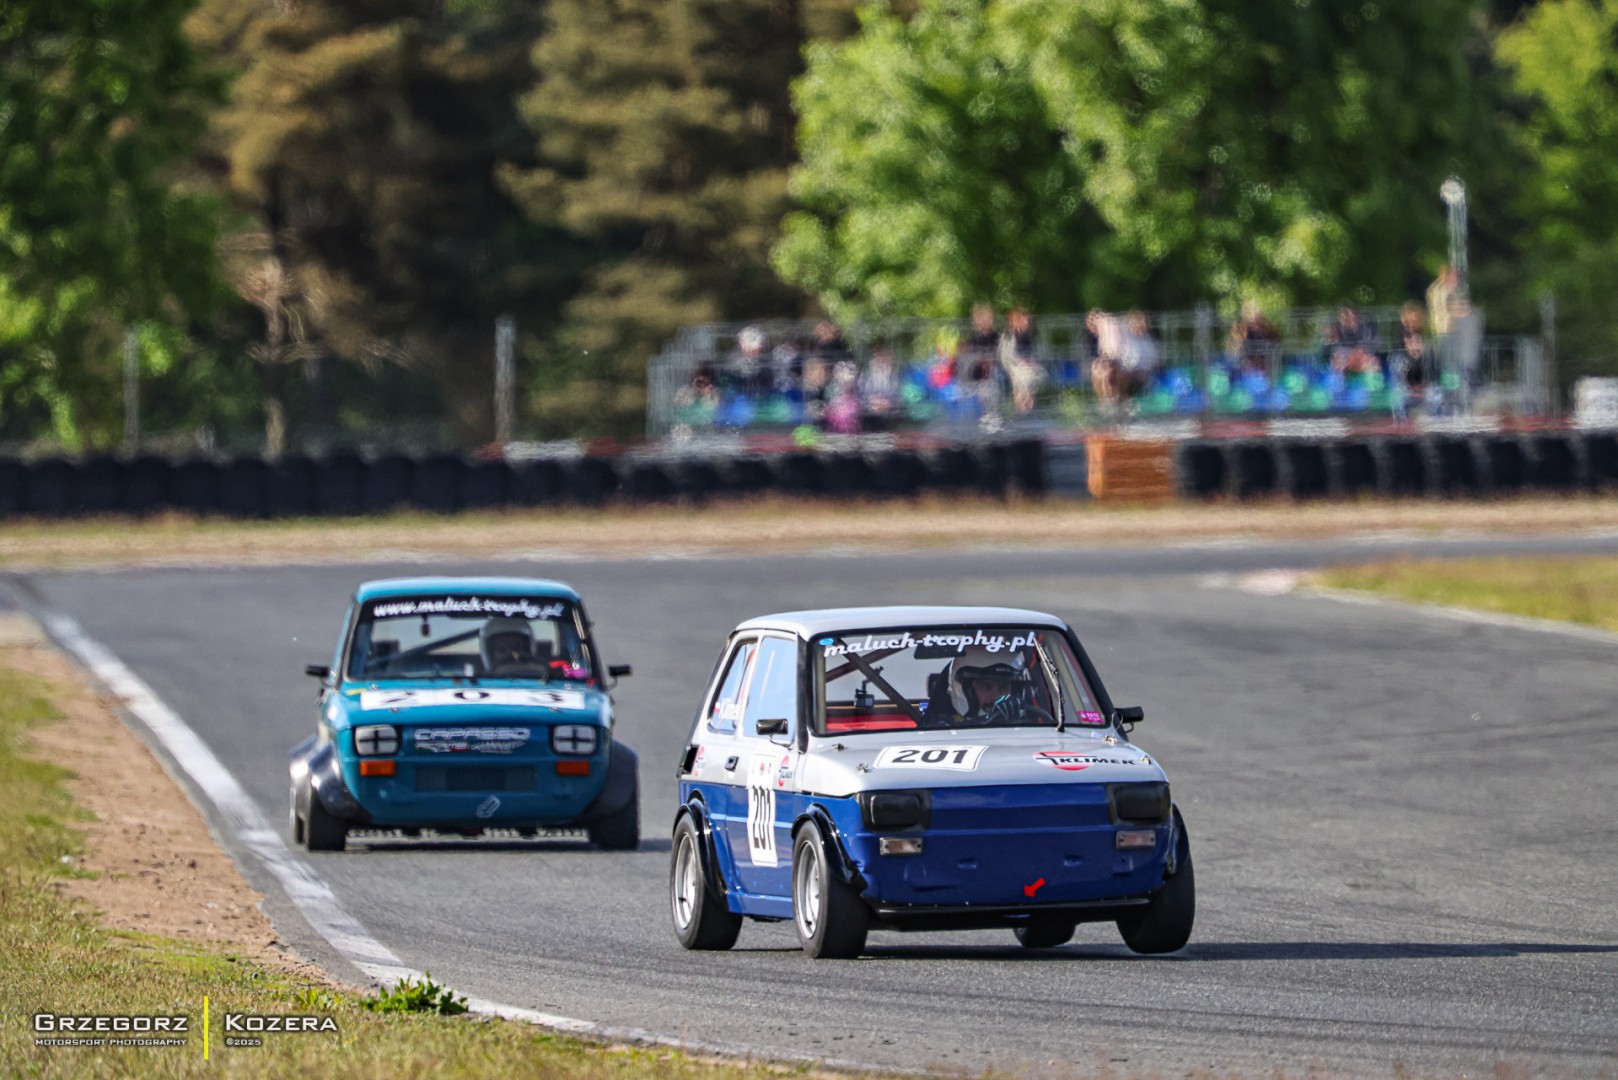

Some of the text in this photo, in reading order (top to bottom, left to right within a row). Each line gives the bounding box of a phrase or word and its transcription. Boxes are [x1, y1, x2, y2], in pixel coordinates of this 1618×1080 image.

[823, 630, 1035, 657] maluch-trophy.pl
[381, 690, 563, 704] 203
[414, 728, 530, 740] CAPASSO
[892, 750, 968, 764] 201
[1058, 757, 1135, 765] KLIMEK
[752, 785, 772, 850] 201
